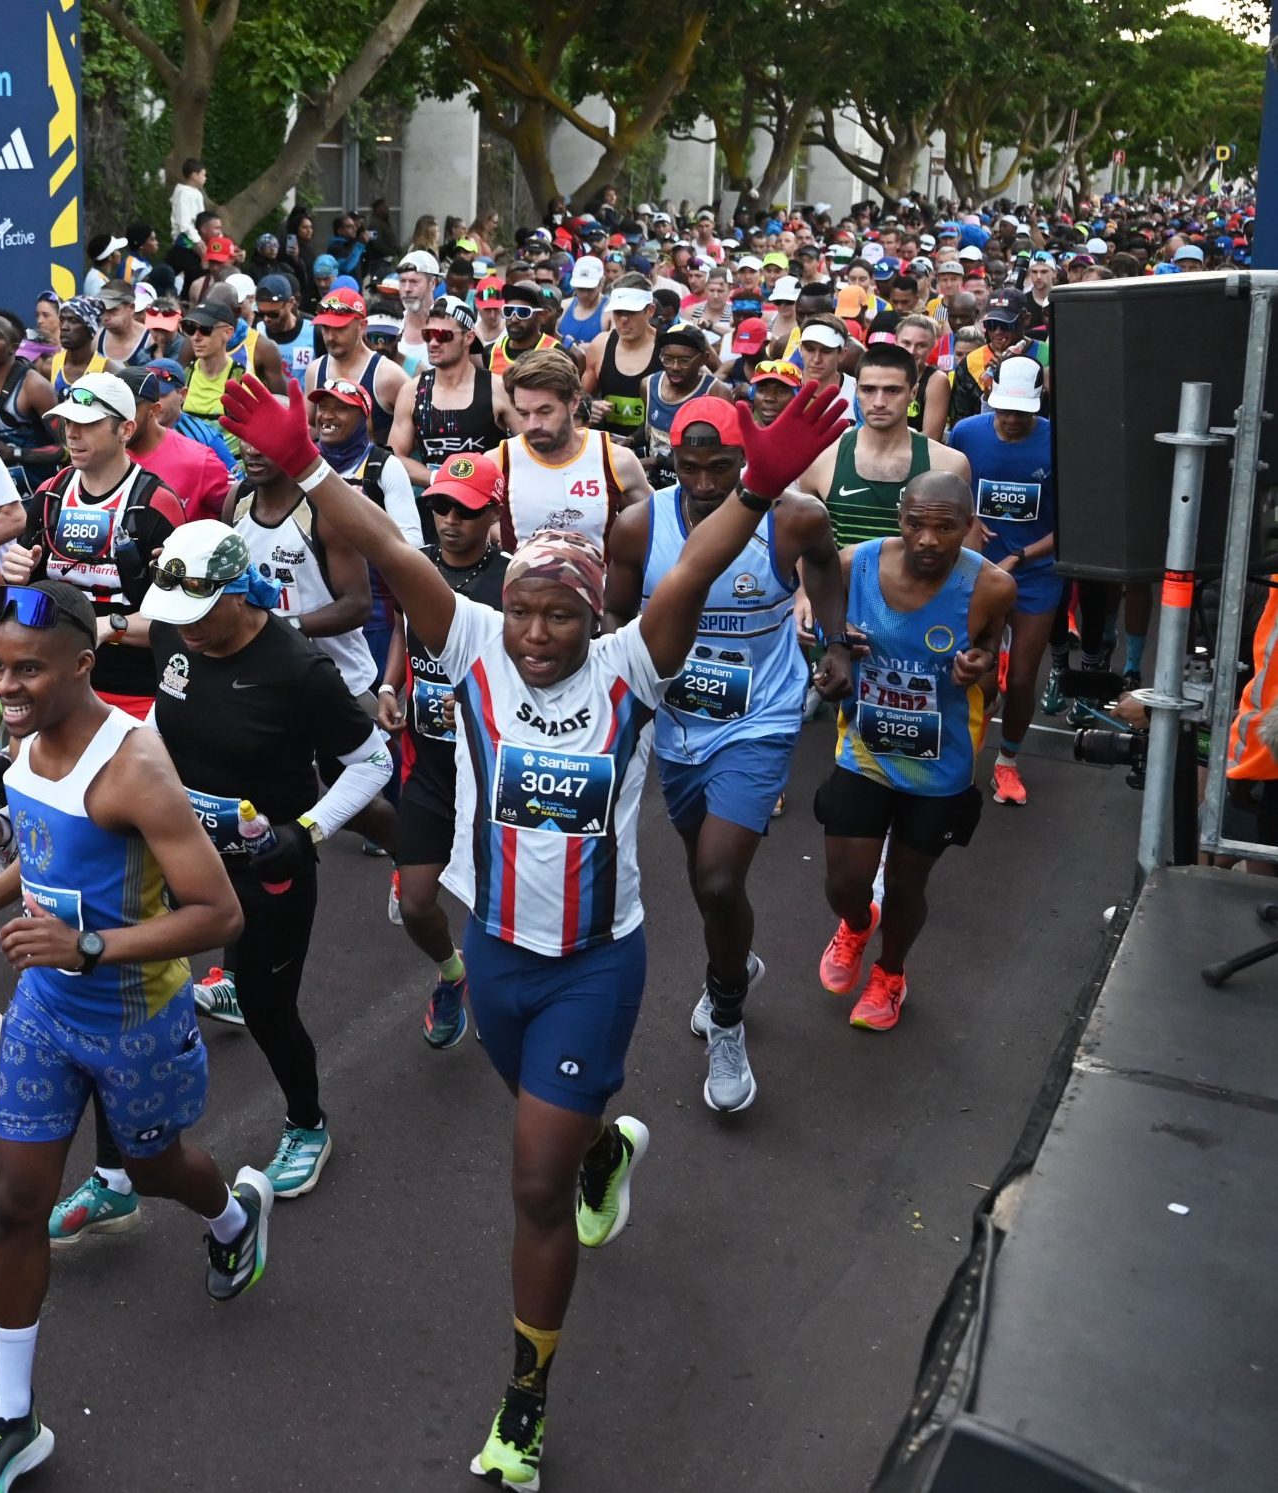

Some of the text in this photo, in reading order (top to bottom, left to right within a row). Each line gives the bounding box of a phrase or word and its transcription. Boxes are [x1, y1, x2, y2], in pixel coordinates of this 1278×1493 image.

[5, 230, 35, 246] active
[297, 350, 310, 365] 45
[614, 403, 643, 416] LAS
[570, 480, 600, 498] 45
[1000, 484, 1027, 492] Sanlam
[991, 492, 1026, 504] 2903
[73, 512, 101, 521] Sanlam
[63, 523, 99, 539] 2860
[89, 563, 120, 577] Harrie
[699, 615, 746, 632] SPORT
[695, 663, 733, 679] Sanlam
[684, 675, 728, 696] 2921
[886, 711, 922, 722] Sanlam
[877, 721, 919, 738] 3126
[538, 755, 590, 772] Sanlam
[521, 771, 588, 798] 3047
[188, 793, 220, 810] anlam
[197, 808, 218, 829] 75
[501, 808, 517, 817] ASA
[541, 810, 577, 819] MARATHON
